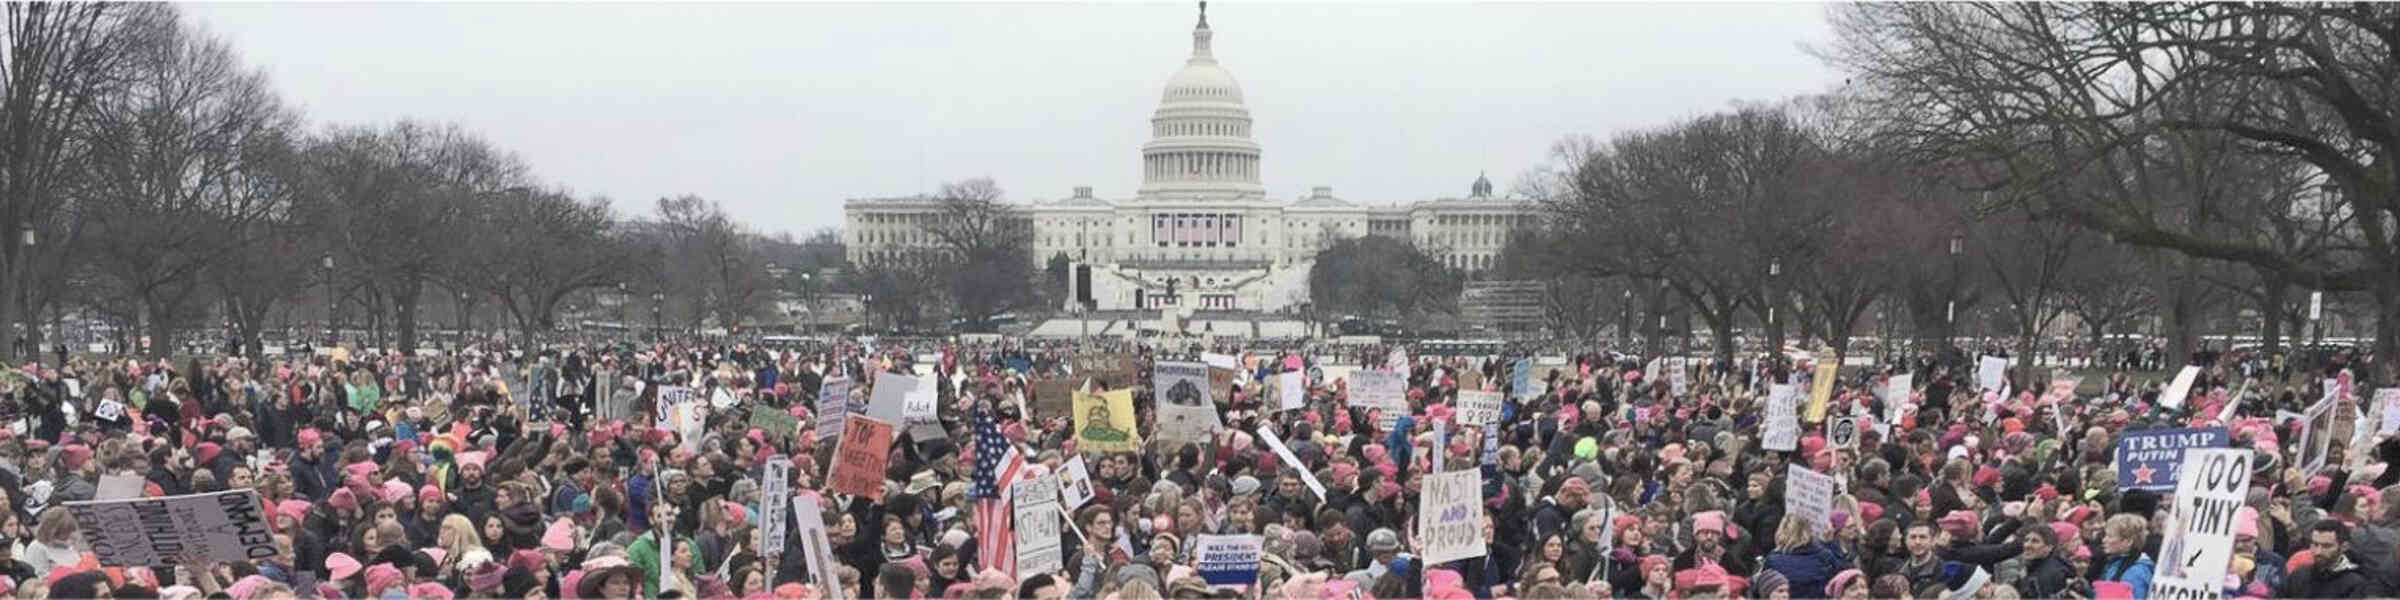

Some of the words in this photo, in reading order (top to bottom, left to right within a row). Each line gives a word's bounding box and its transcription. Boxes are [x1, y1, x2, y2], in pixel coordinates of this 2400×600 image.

[2124, 432, 2216, 451] TRUMP
[2127, 450, 2178, 462] PUTIN
[218, 492, 279, 559] DEMAND
[1440, 504, 1467, 523] AND
[2189, 496, 2241, 535] TINY
[1425, 522, 1475, 556] PROUD
